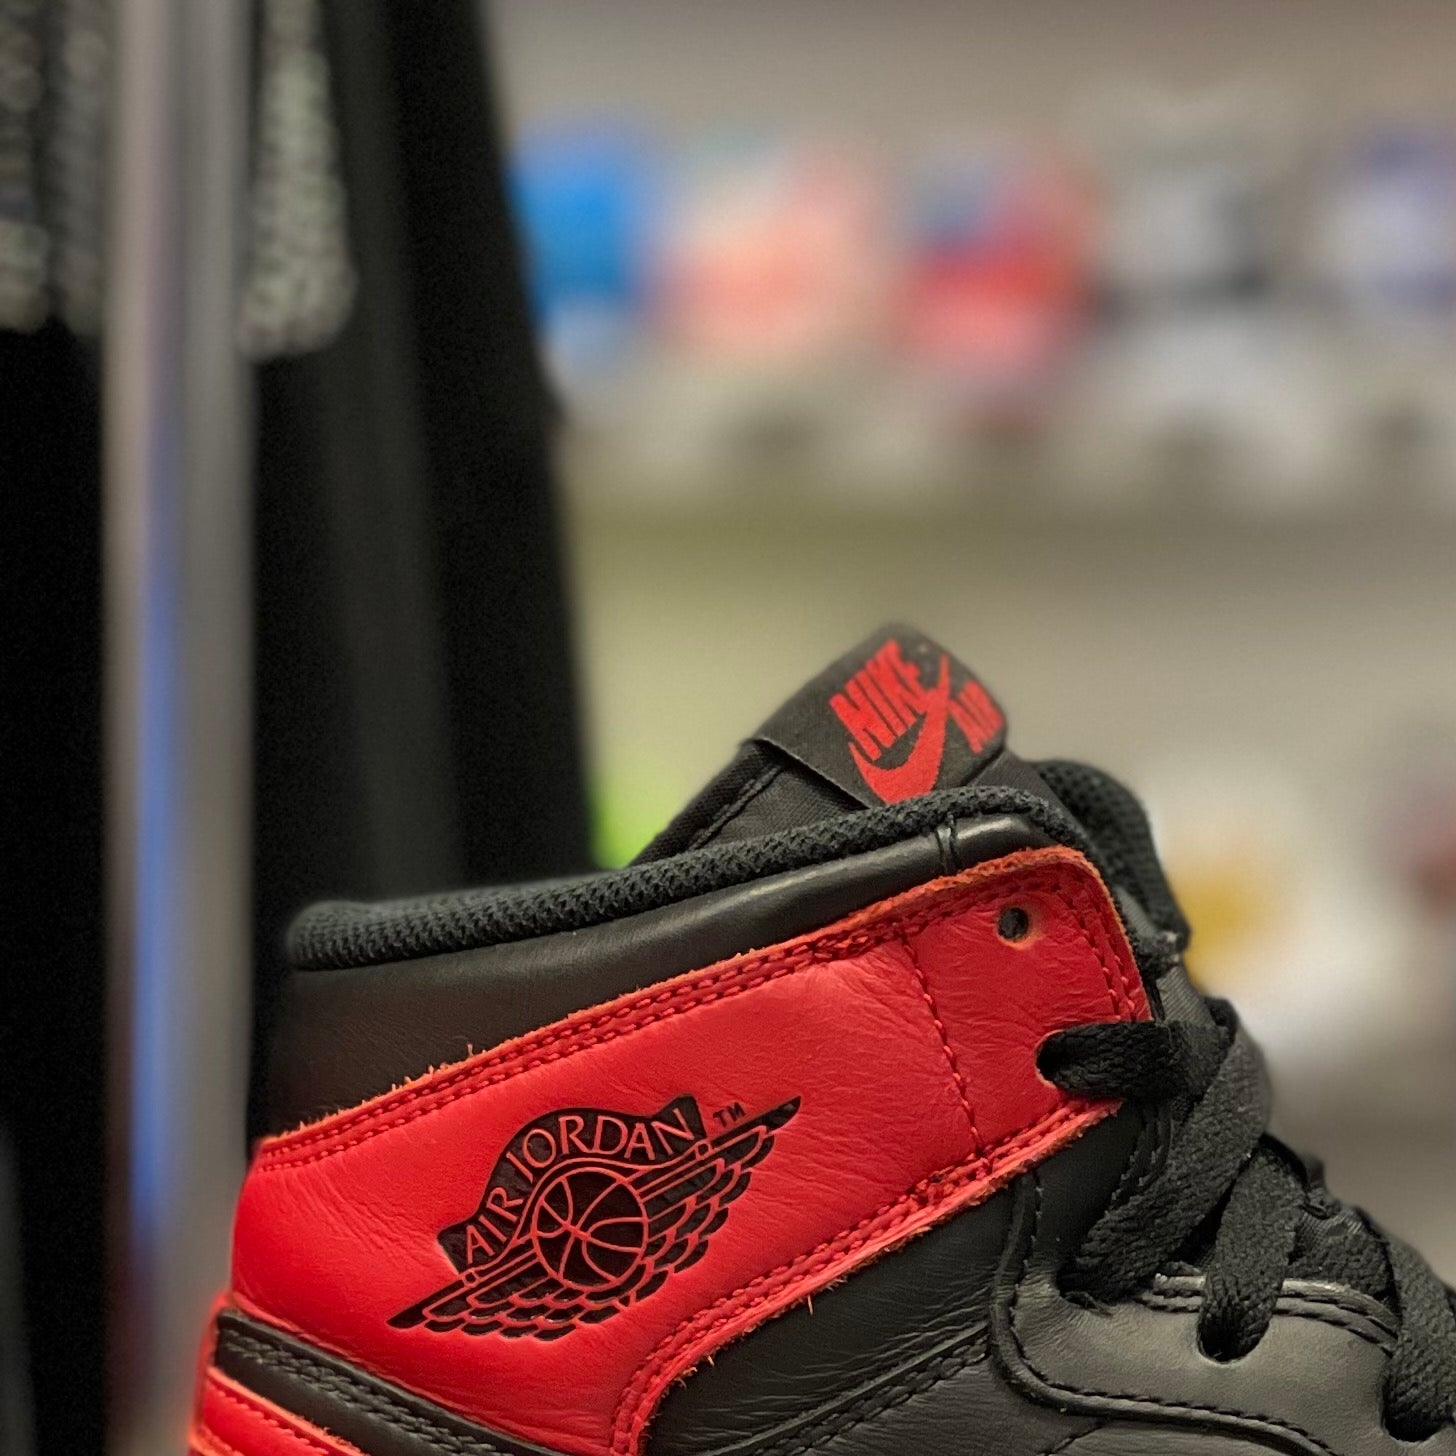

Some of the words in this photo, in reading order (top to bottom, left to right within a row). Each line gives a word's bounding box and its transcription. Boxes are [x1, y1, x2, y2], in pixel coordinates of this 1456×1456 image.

[829, 638, 931, 760] NIKE
[465, 1187, 524, 1265] AIR
[506, 1108, 696, 1184] JORDAN
